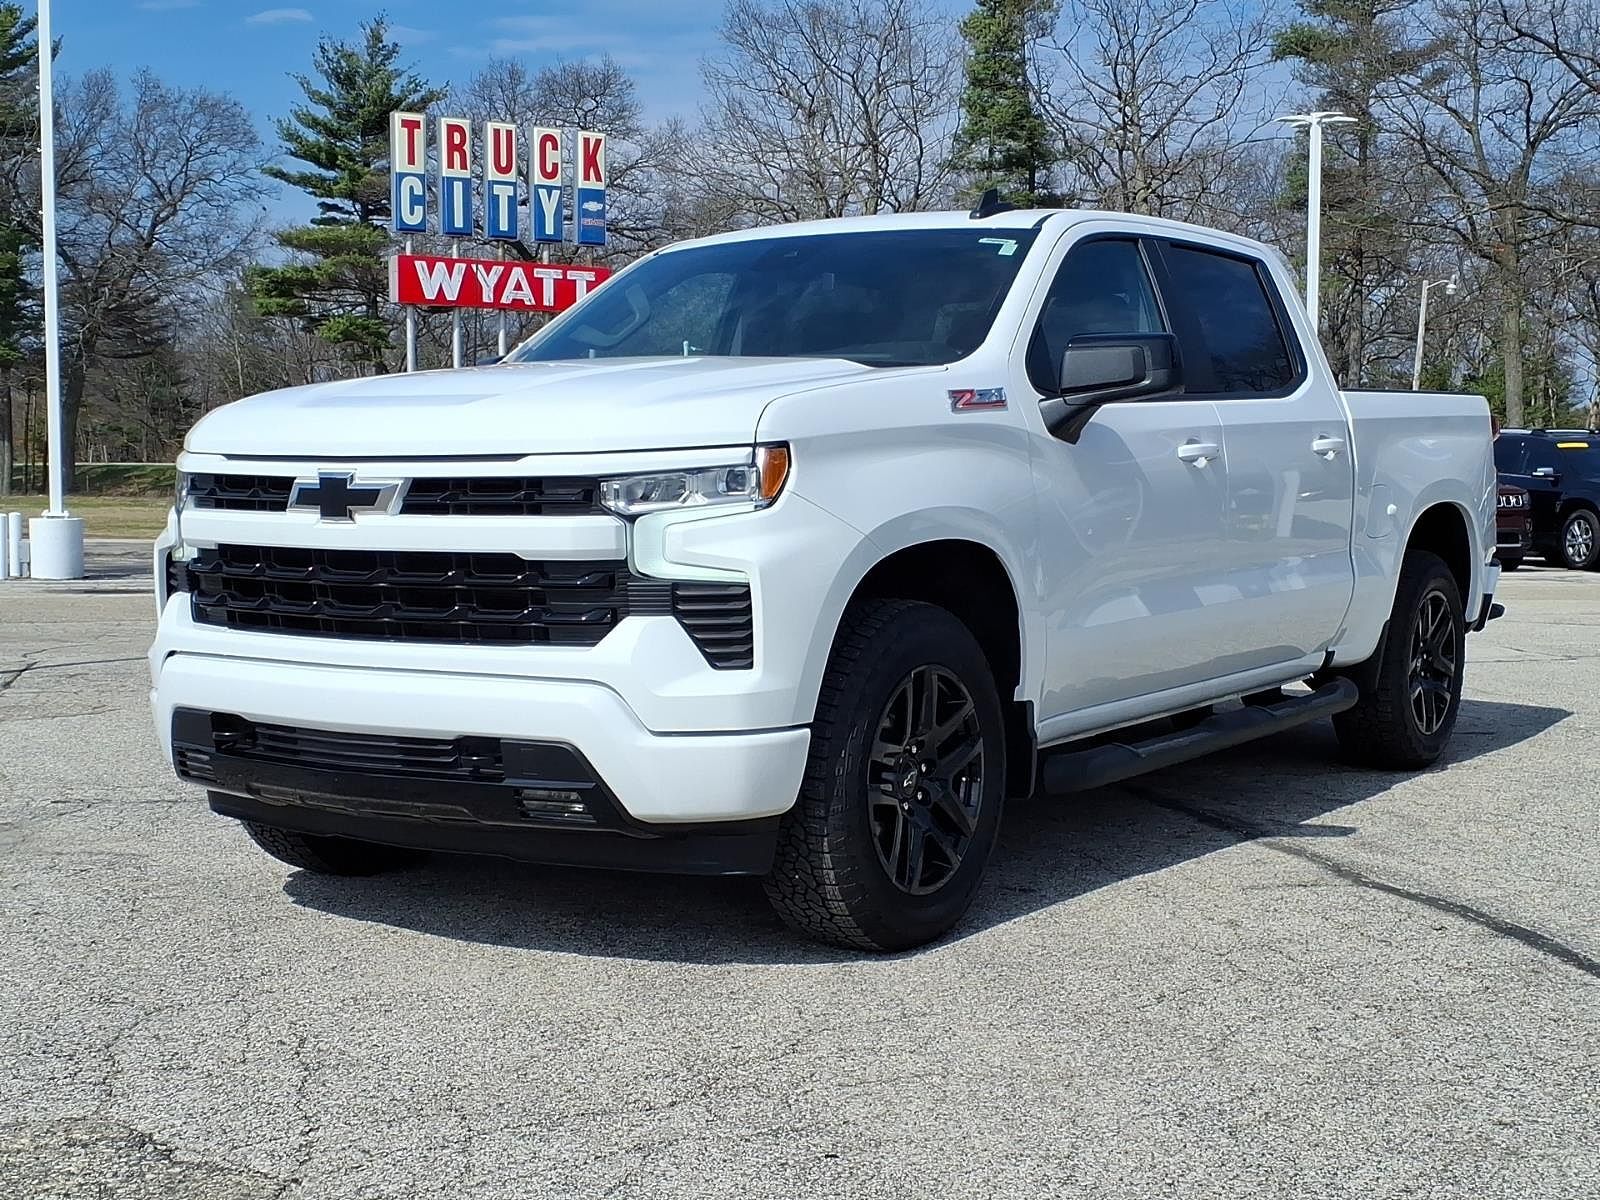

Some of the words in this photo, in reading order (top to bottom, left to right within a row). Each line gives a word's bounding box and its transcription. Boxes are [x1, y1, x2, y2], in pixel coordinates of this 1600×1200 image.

[400, 118, 603, 183] TRUCK
[400, 176, 561, 235] CITY
[414, 260, 596, 306] WYATT
[948, 387, 1008, 413] Z71
